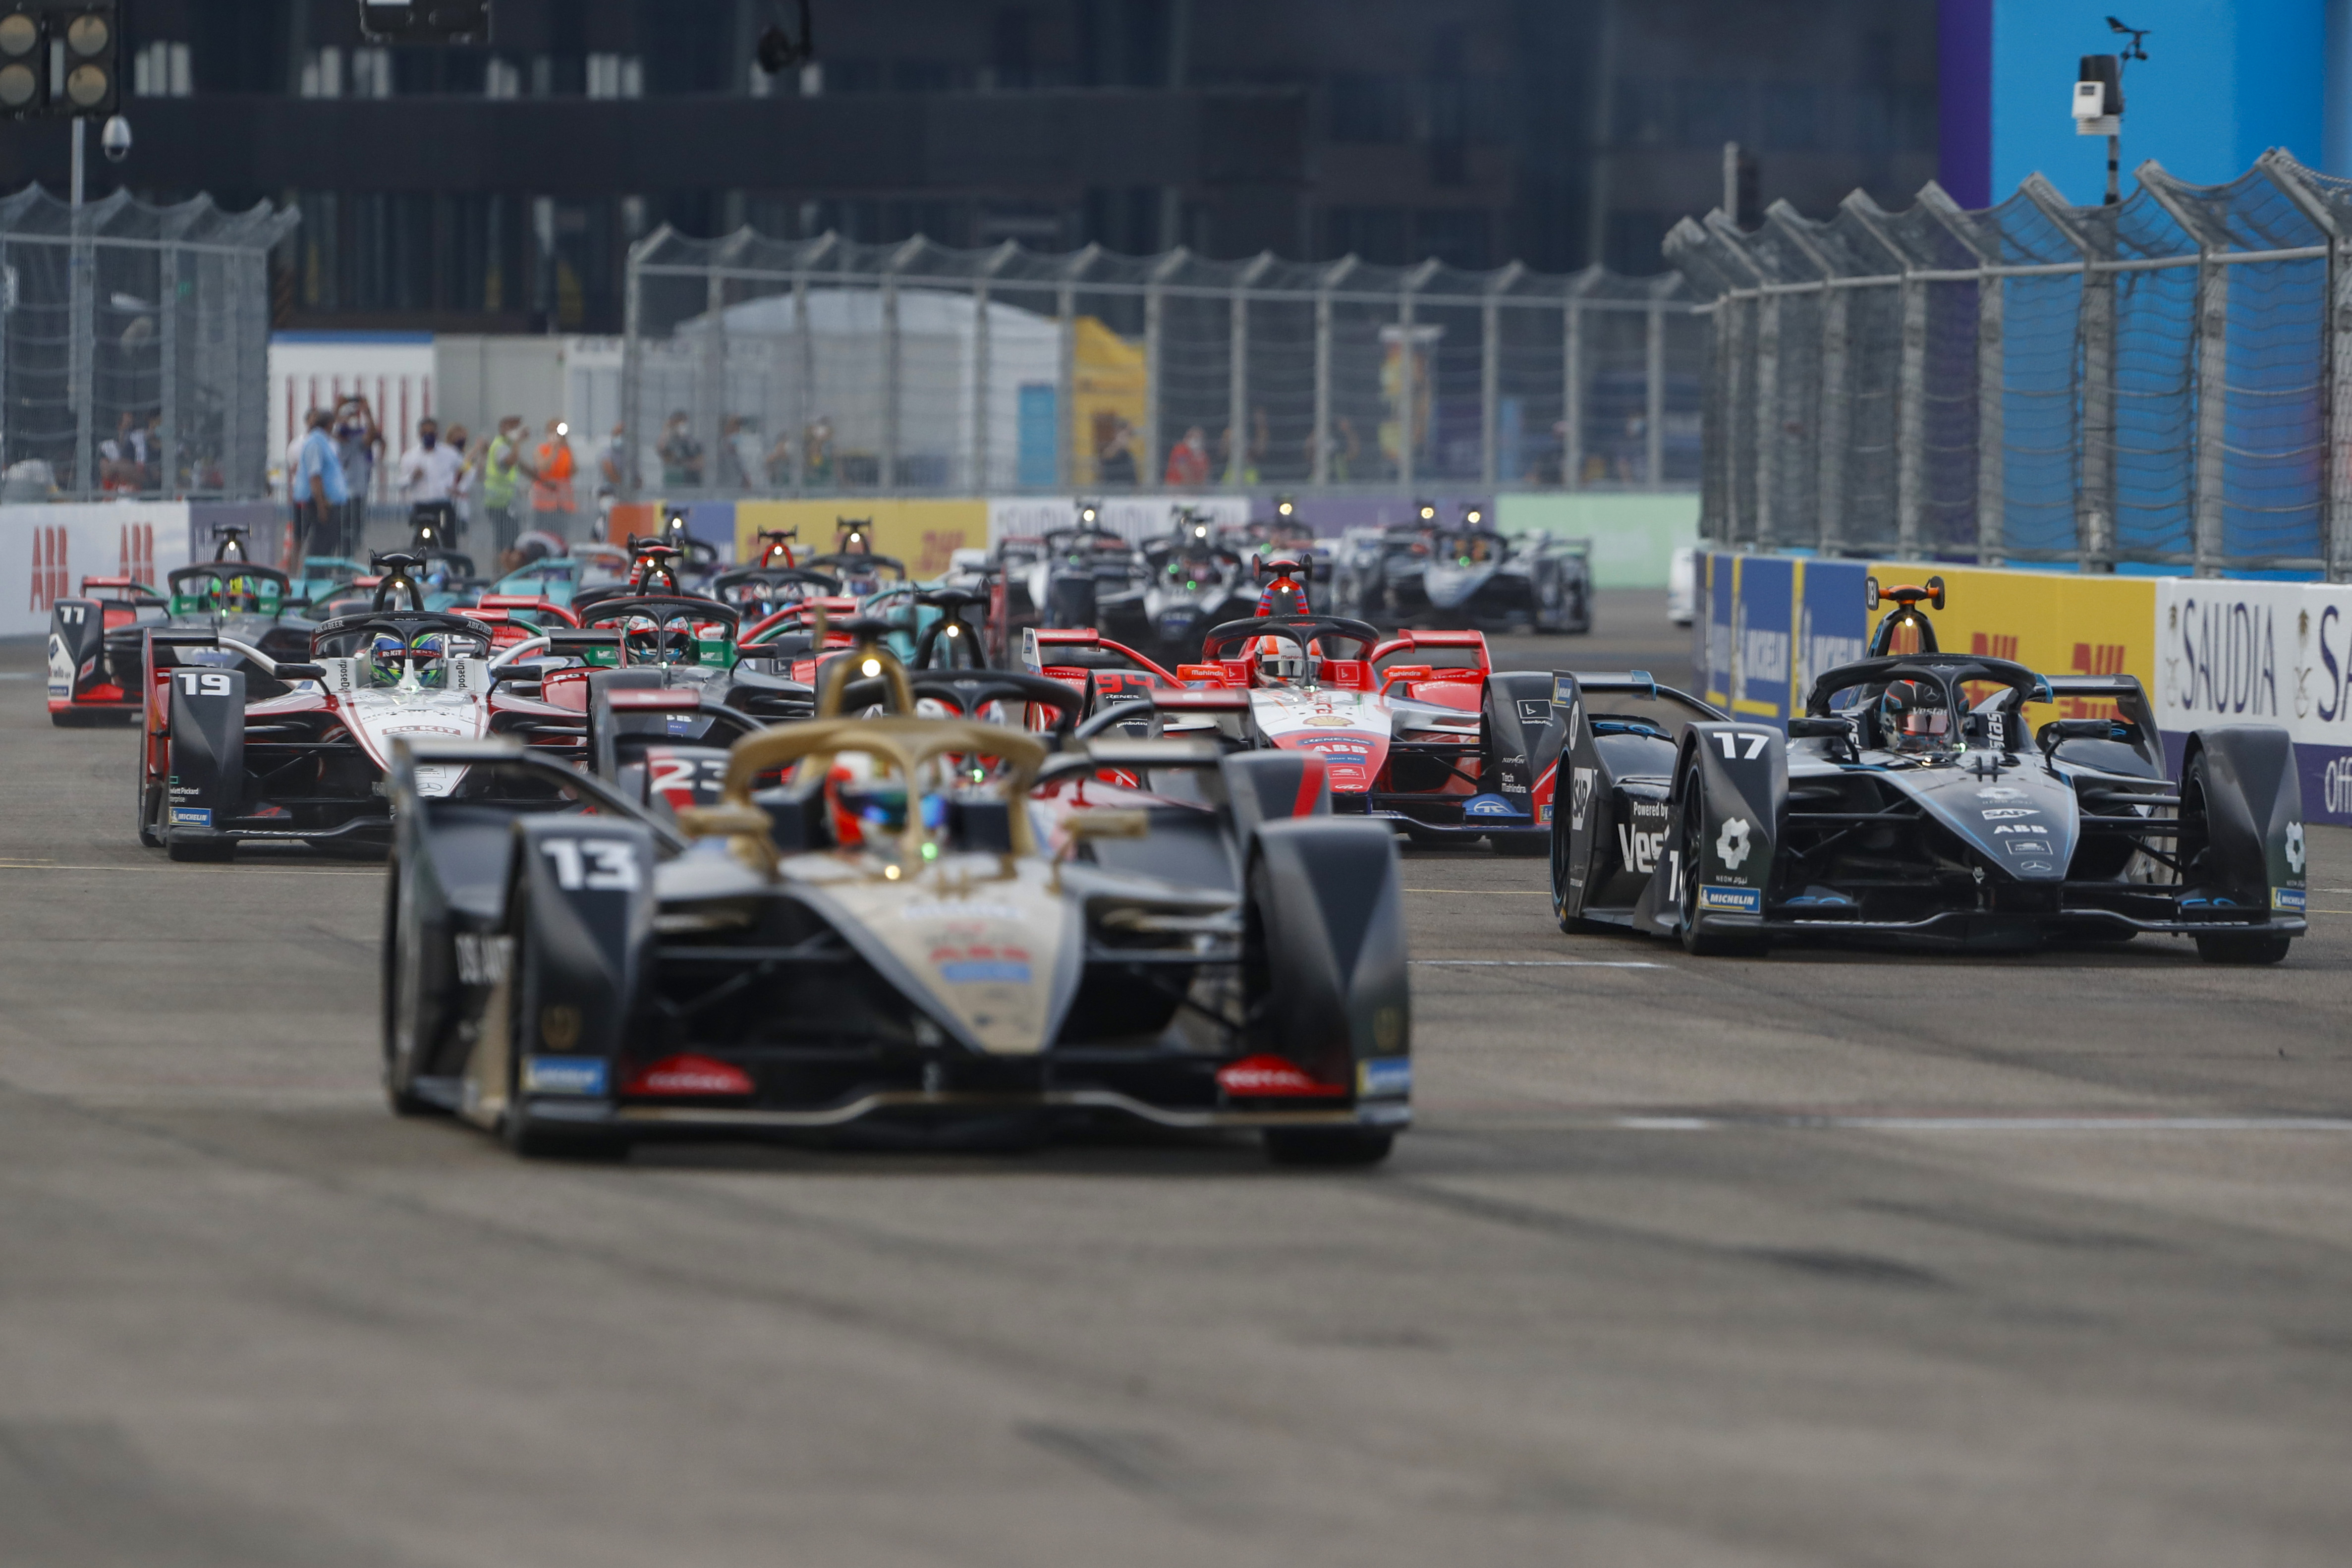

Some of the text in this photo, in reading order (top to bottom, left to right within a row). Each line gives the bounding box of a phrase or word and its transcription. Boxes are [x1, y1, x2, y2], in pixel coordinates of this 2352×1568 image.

[60, 606, 85, 624] 11
[327, 620, 344, 630] BEER
[2182, 598, 2277, 717] SAUDIA
[178, 673, 230, 696] 19
[1095, 674, 1155, 696] 94
[1312, 744, 1368, 754] ABB
[1713, 732, 1770, 760] 17
[650, 758, 727, 794] 23
[1501, 772, 1514, 783] Tech
[1501, 783, 1526, 793] Mahindra
[1633, 801, 1669, 820] Powered by
[1994, 824, 2048, 835] ABB
[1618, 823, 1670, 874] Ves
[540, 839, 642, 891] 13
[1710, 893, 1754, 905] MICHELIN
